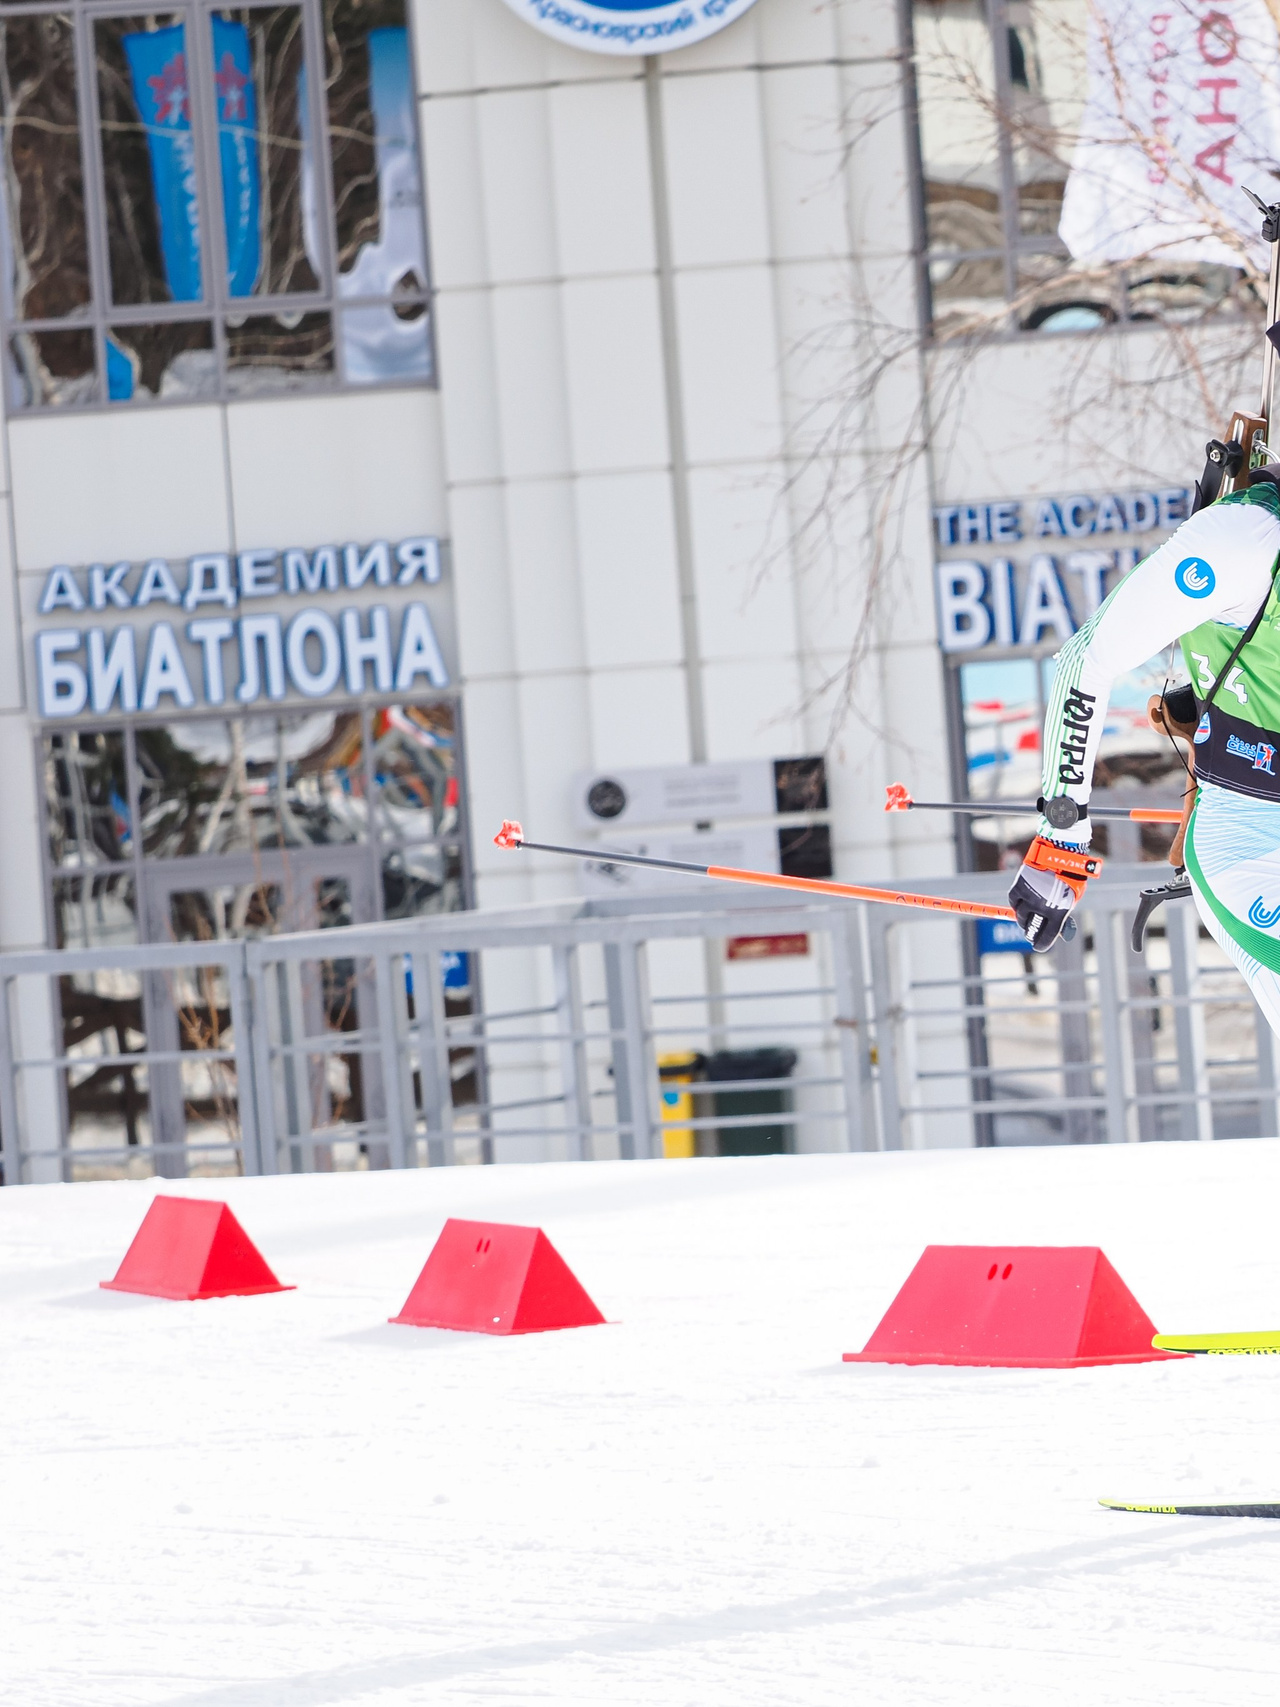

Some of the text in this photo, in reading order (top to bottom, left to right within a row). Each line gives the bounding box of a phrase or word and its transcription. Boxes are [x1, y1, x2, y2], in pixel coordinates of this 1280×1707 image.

[935, 501, 1023, 546] THE
[38, 535, 443, 614] АКАДЕМИЯ
[936, 549, 1141, 651] BIAT
[36, 602, 449, 718] БИАТЛОНА
